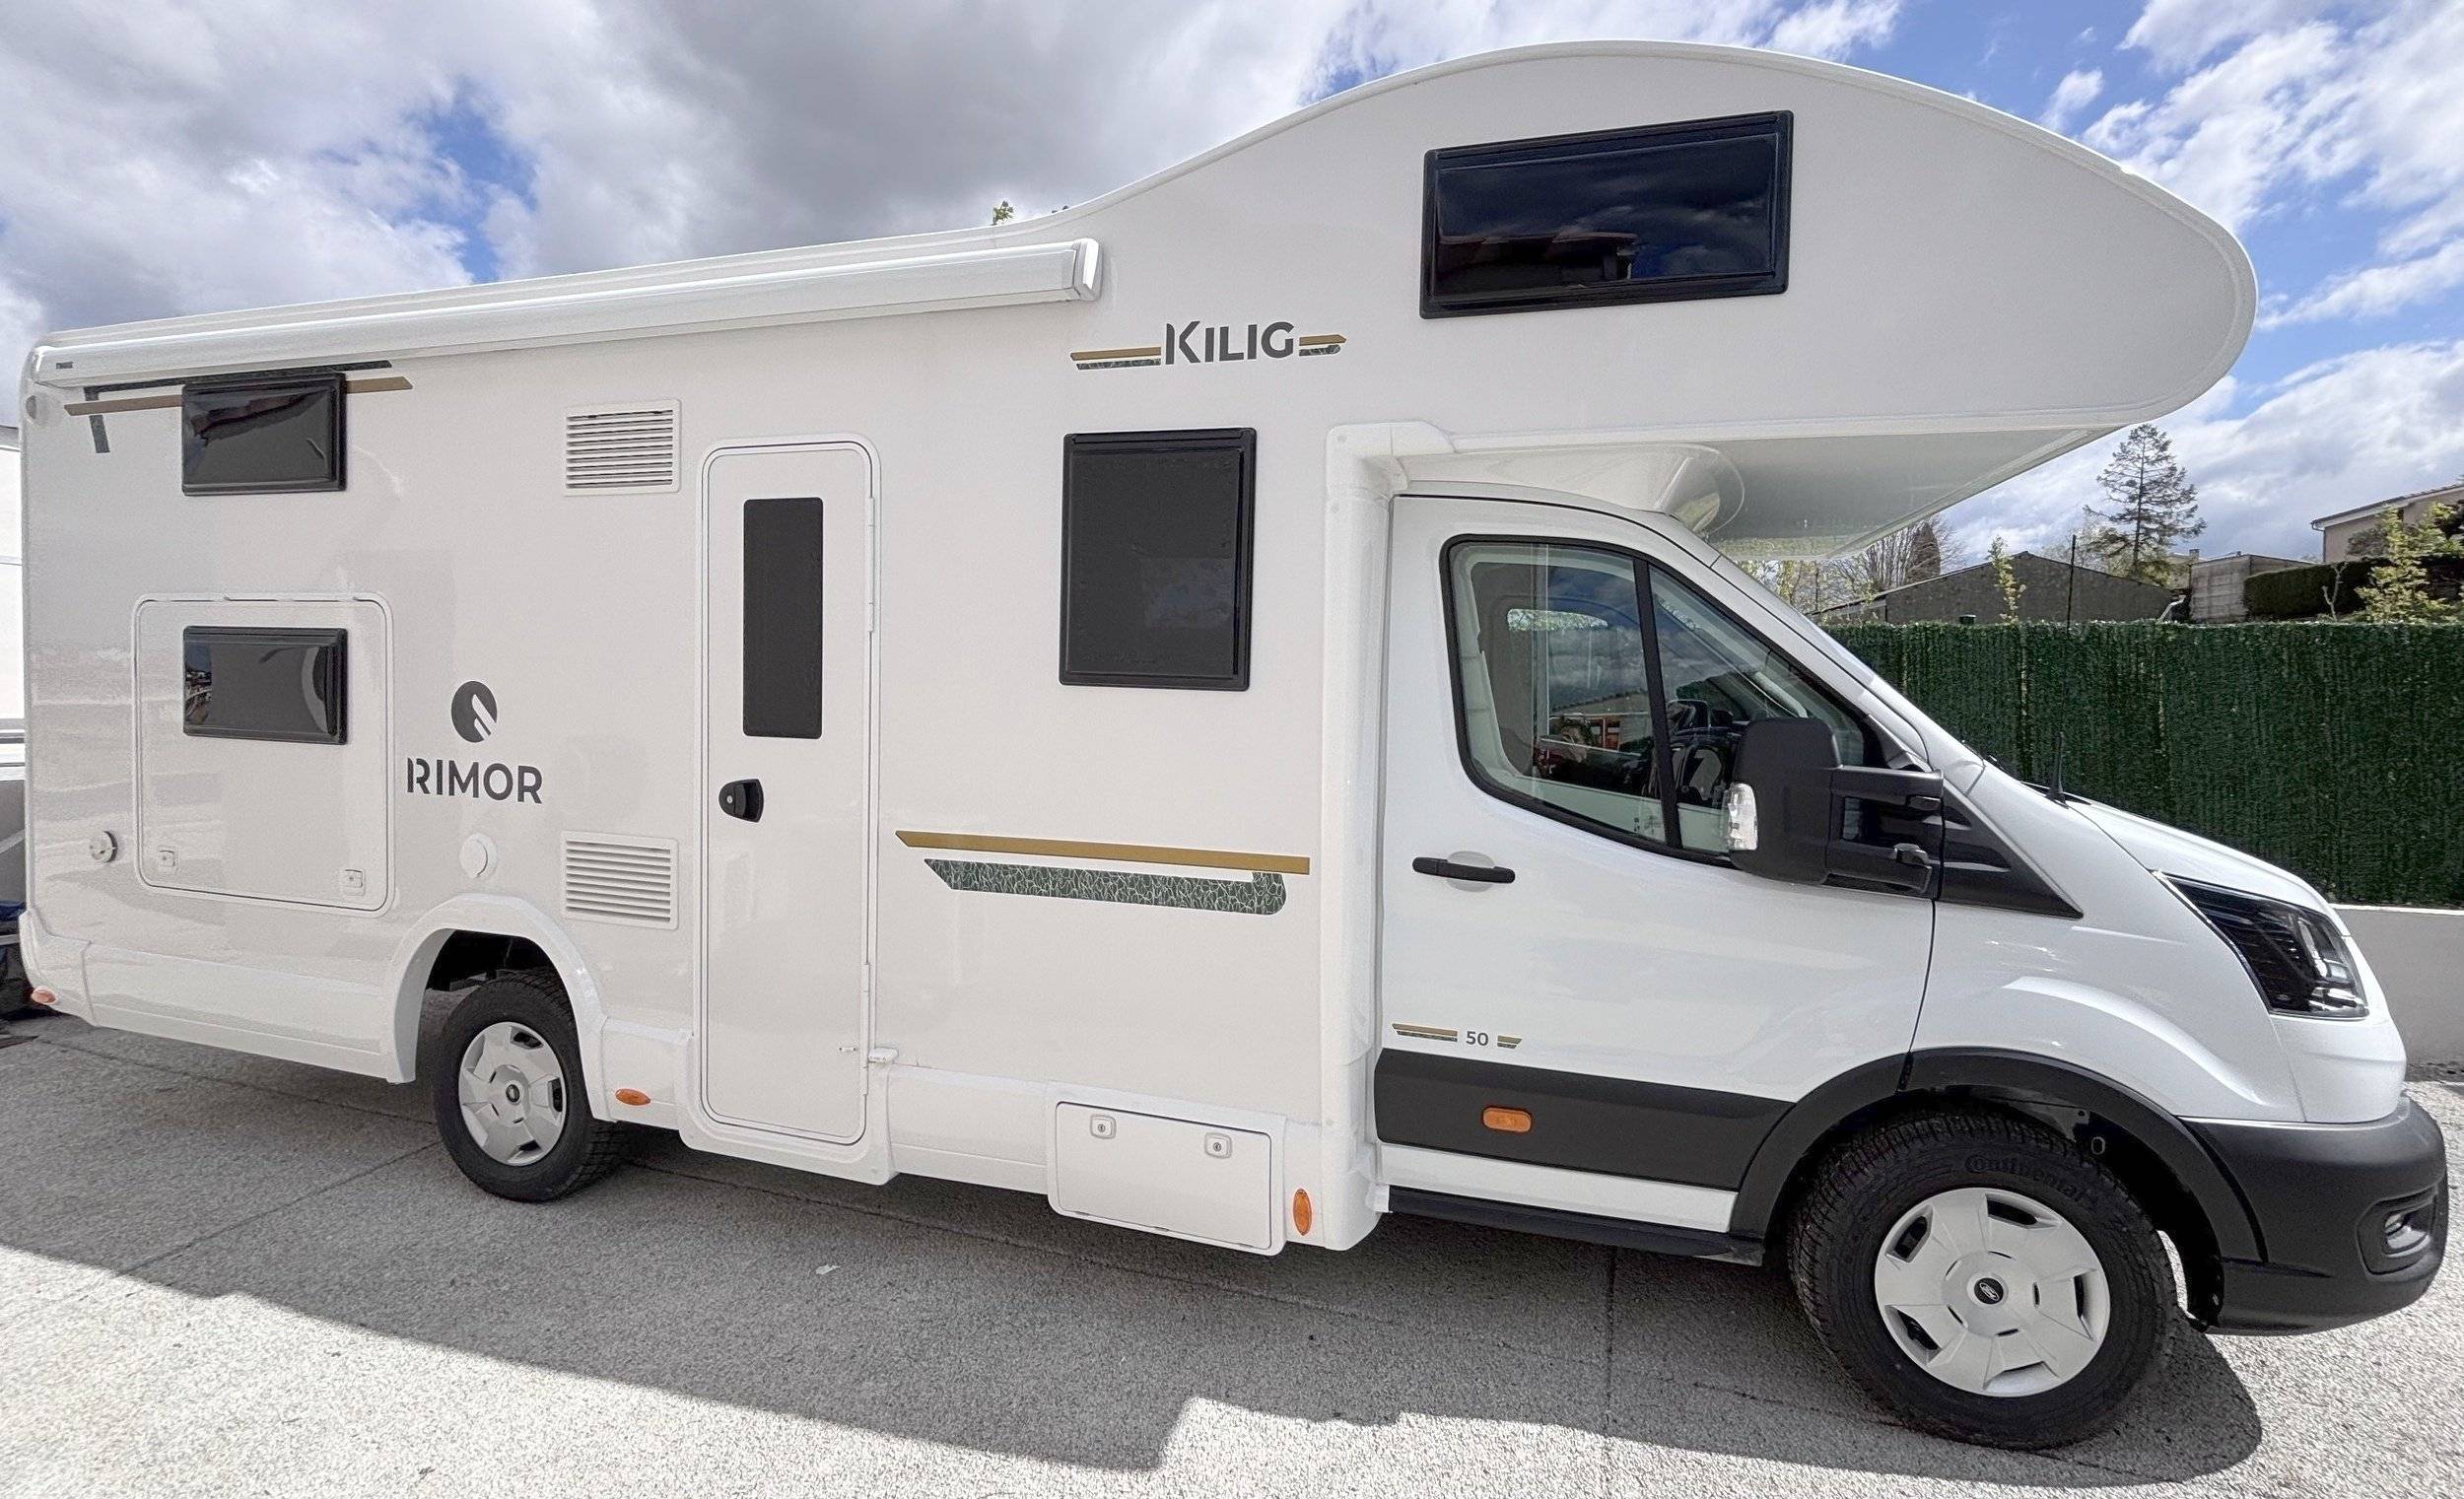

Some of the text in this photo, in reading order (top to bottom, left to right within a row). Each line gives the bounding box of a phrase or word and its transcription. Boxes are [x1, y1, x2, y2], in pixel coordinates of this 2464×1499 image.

[1165, 320, 1295, 366] KILIG
[407, 757, 543, 804] RIMOR
[1466, 1030, 1489, 1047] 50
